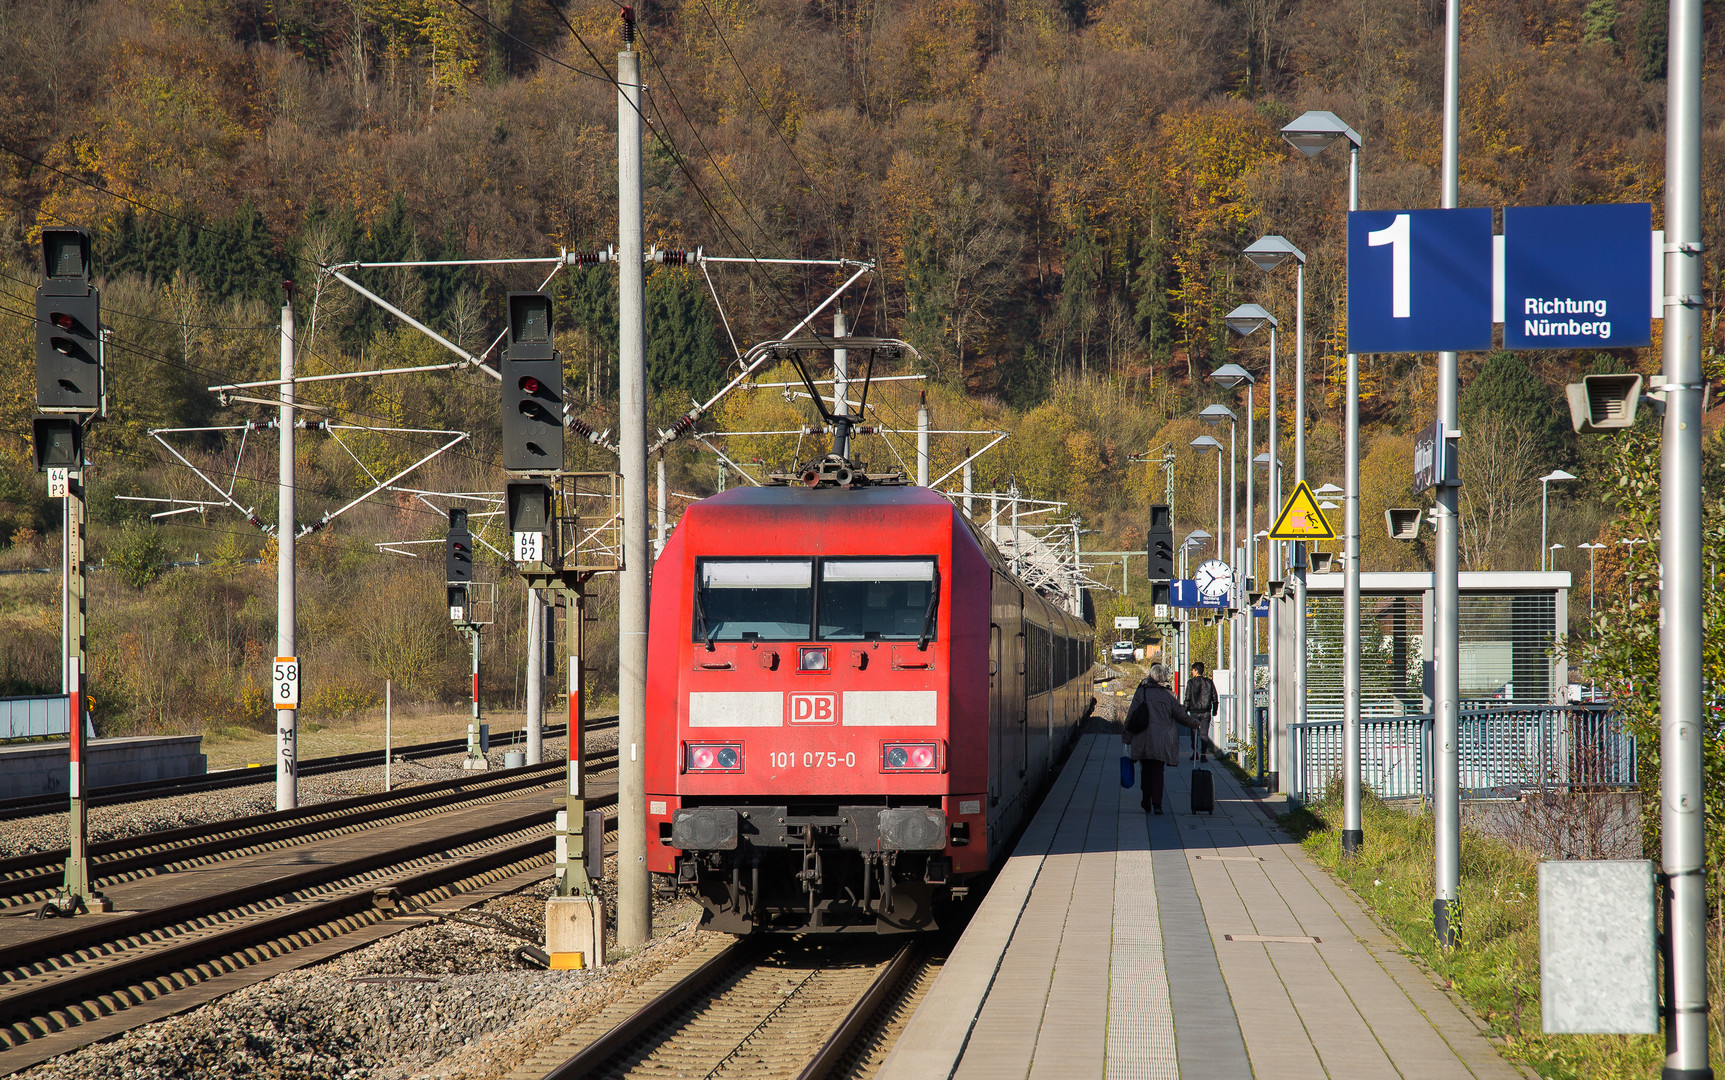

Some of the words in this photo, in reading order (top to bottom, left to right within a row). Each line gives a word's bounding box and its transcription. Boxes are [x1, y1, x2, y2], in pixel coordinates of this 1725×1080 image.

[1368, 214, 1410, 317] 1
[1524, 298, 1607, 316] Richtung
[1524, 319, 1611, 338] Nürnberg
[51, 470, 64, 480] 64
[52, 484, 65, 494] P3
[521, 533, 535, 546] 64
[521, 547, 535, 560] P2
[1173, 580, 1183, 600] 1
[274, 665, 297, 681] 58
[280, 682, 291, 699] 8
[794, 697, 832, 720] DB
[770, 752, 795, 768] 101
[803, 752, 856, 768] 075-0
